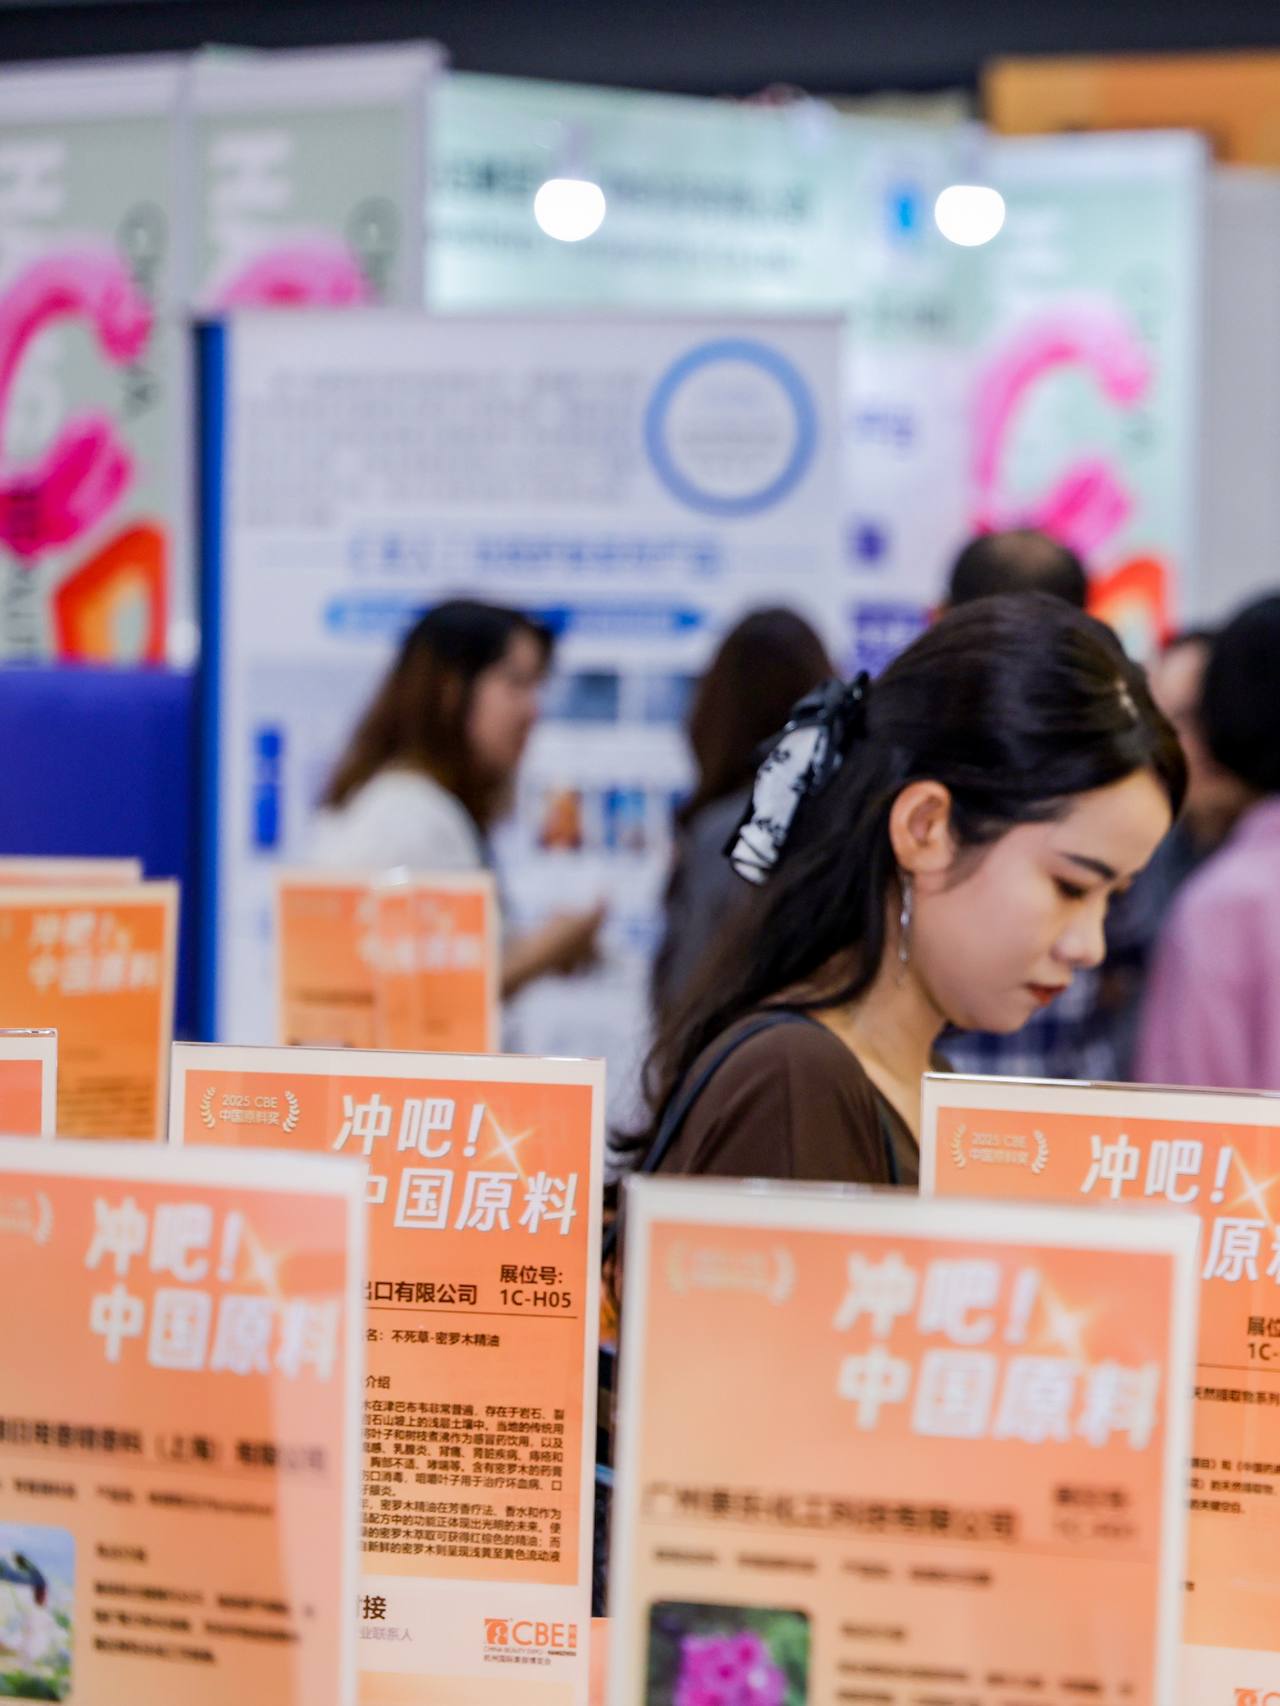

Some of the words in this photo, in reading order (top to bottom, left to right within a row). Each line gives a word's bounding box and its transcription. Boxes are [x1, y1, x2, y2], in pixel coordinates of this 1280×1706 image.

[222, 1094, 250, 1107] 2025
[254, 1095, 278, 1108] CBE
[219, 1109, 279, 1126] 中国原料奖
[500, 1289, 572, 1308] 1C-H05
[88, 1284, 342, 1382] 中国原料
[366, 1376, 391, 1389] 介绍
[837, 1346, 1161, 1450] 中国原料
[357, 1594, 387, 1620] 接
[512, 1621, 564, 1648] CBE
